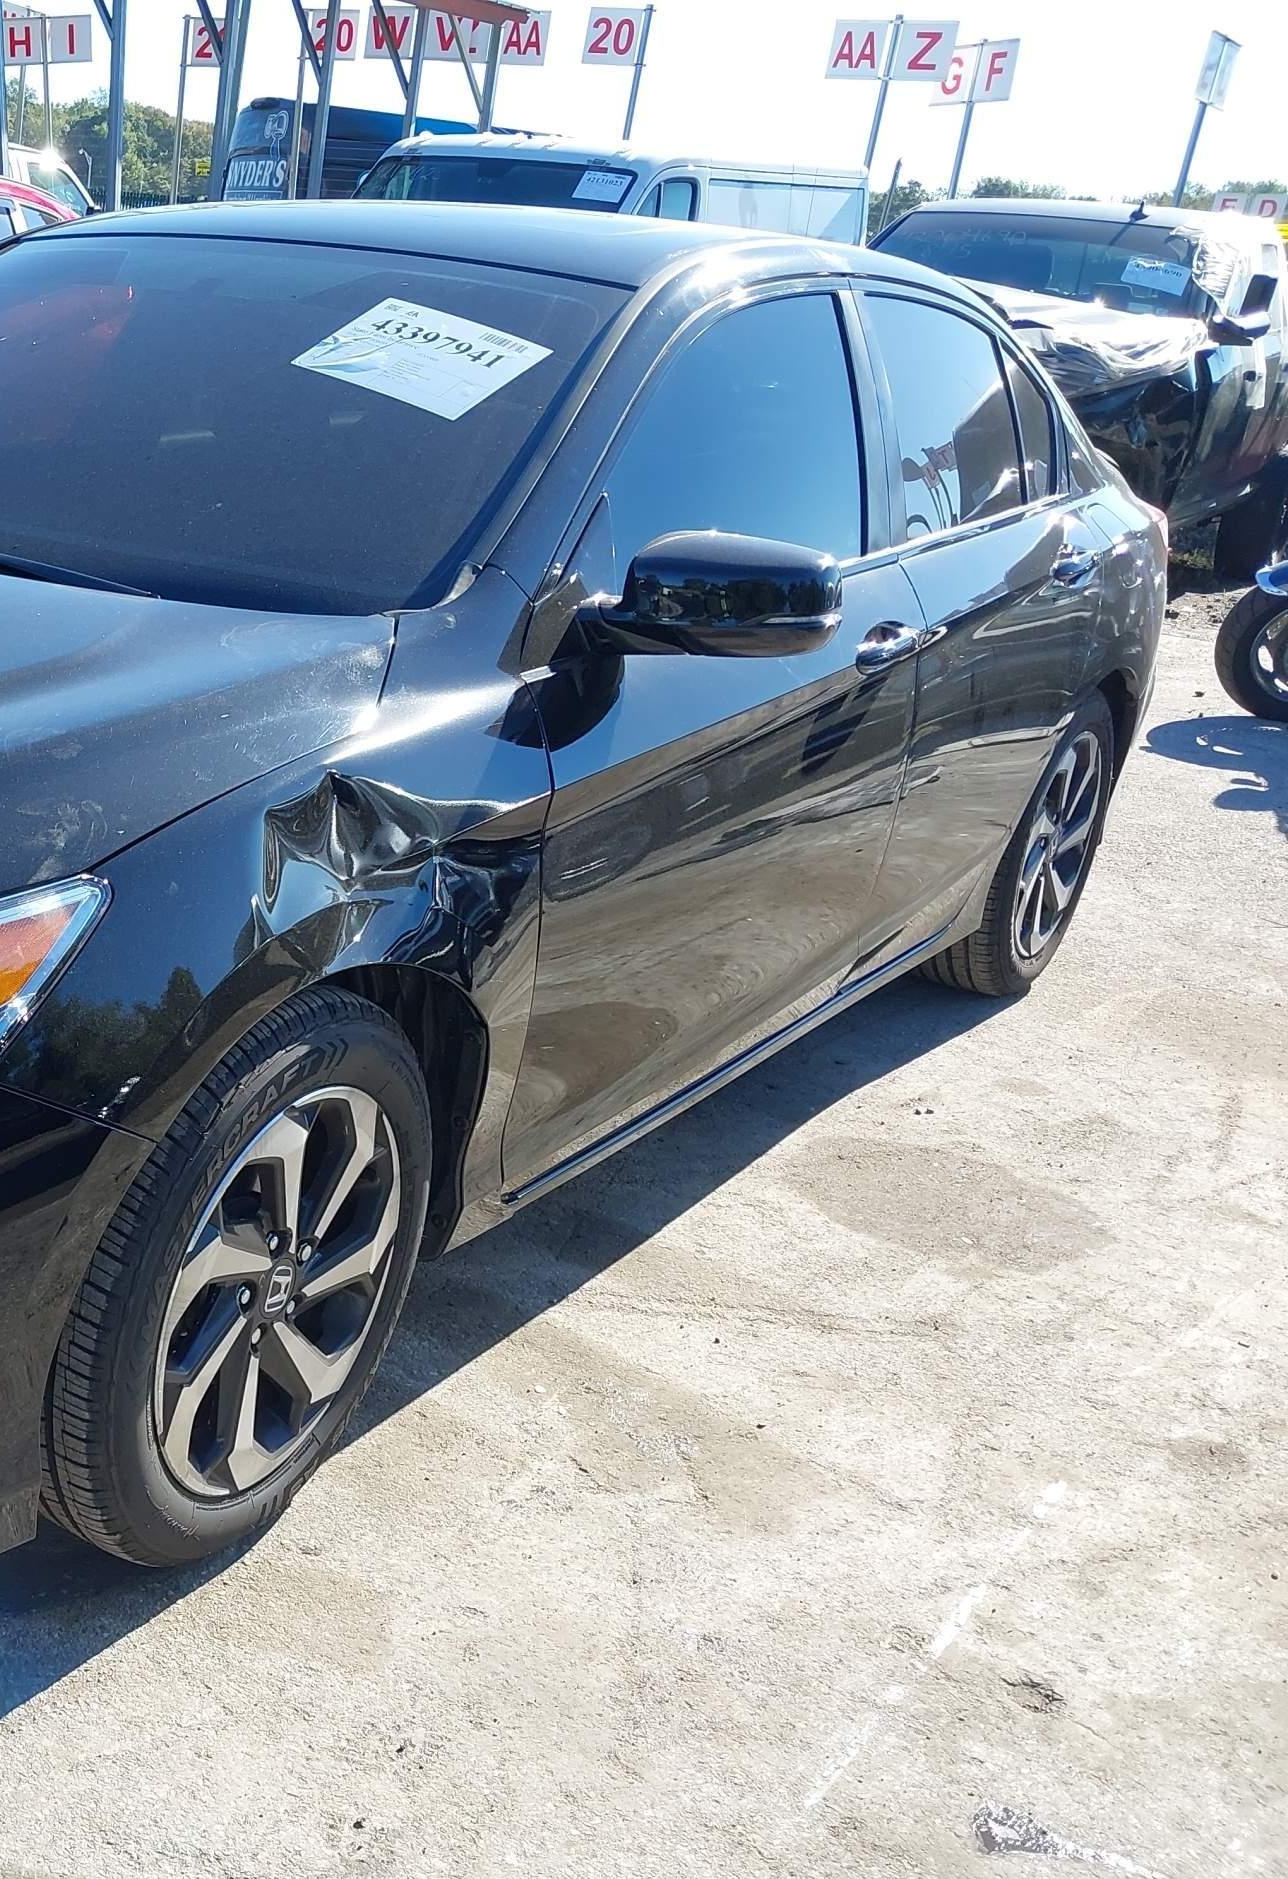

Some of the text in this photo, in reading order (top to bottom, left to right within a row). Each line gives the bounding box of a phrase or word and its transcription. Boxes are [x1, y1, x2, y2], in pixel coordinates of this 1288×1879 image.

[9, 24, 75, 57] H I
[314, 18, 354, 52] 20
[372, 16, 411, 50] W
[503, 20, 541, 56] AA
[587, 17, 635, 56] 20
[832, 31, 943, 71] AA Z
[940, 51, 1008, 95] G F
[1258, 199, 1278, 217] D
[370, 319, 505, 369] 43397941
